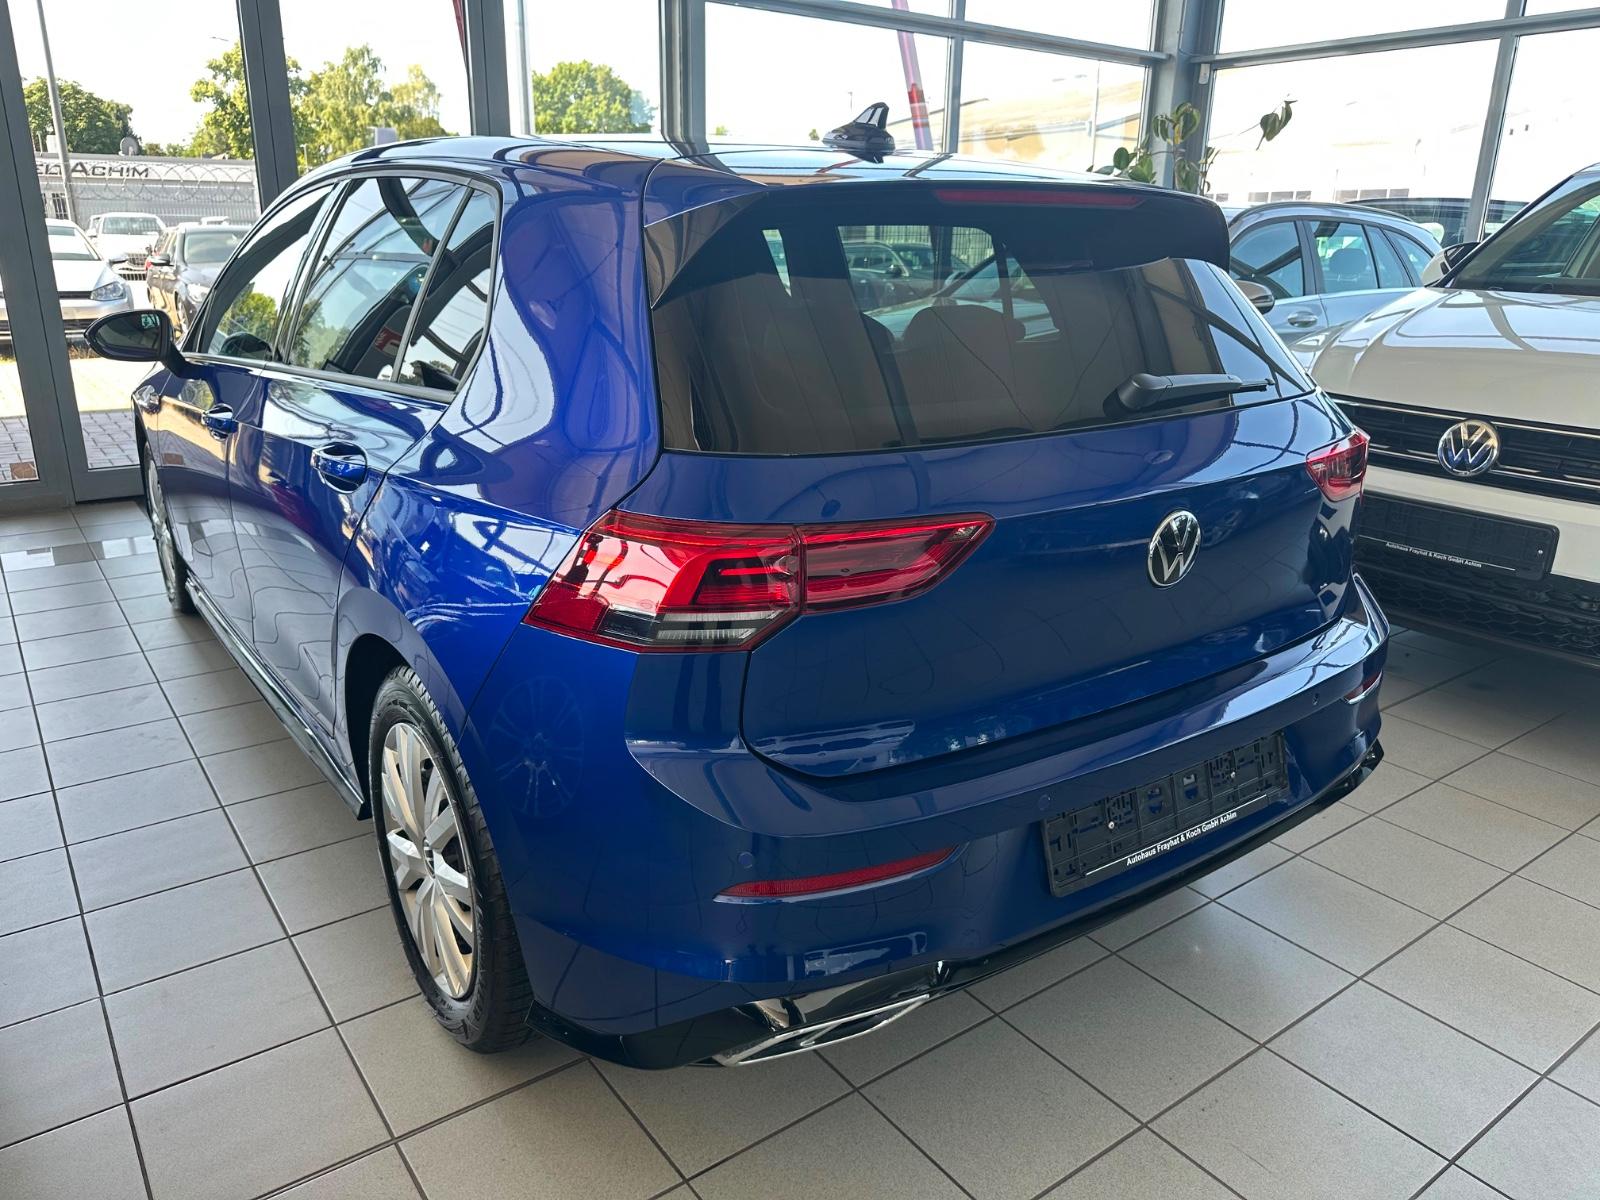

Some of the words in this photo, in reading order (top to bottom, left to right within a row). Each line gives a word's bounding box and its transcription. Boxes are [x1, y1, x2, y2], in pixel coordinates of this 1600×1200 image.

[1126, 847, 1156, 866] Autohaus
[1157, 837, 1180, 852] Frayhat
[1186, 828, 1201, 840] Koch
[1202, 819, 1219, 832] GmbH
[1219, 811, 1237, 824] Achim
